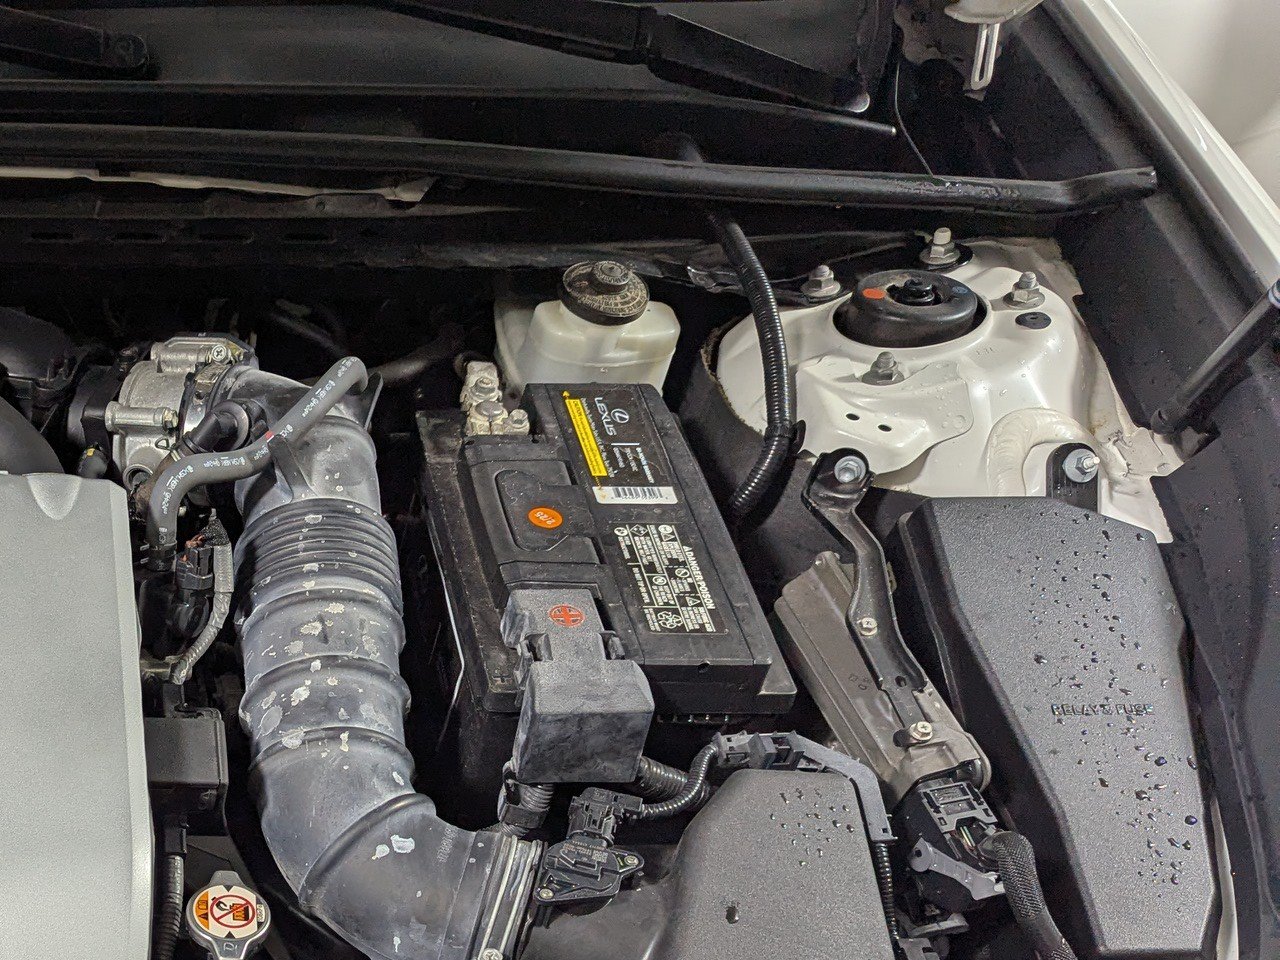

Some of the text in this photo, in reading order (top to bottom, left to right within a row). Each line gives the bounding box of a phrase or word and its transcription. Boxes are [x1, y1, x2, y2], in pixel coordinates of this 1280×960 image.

[594, 397, 617, 436] LEXUS
[1051, 704, 1100, 715] RELAY
[1115, 704, 1154, 715] FUSE
